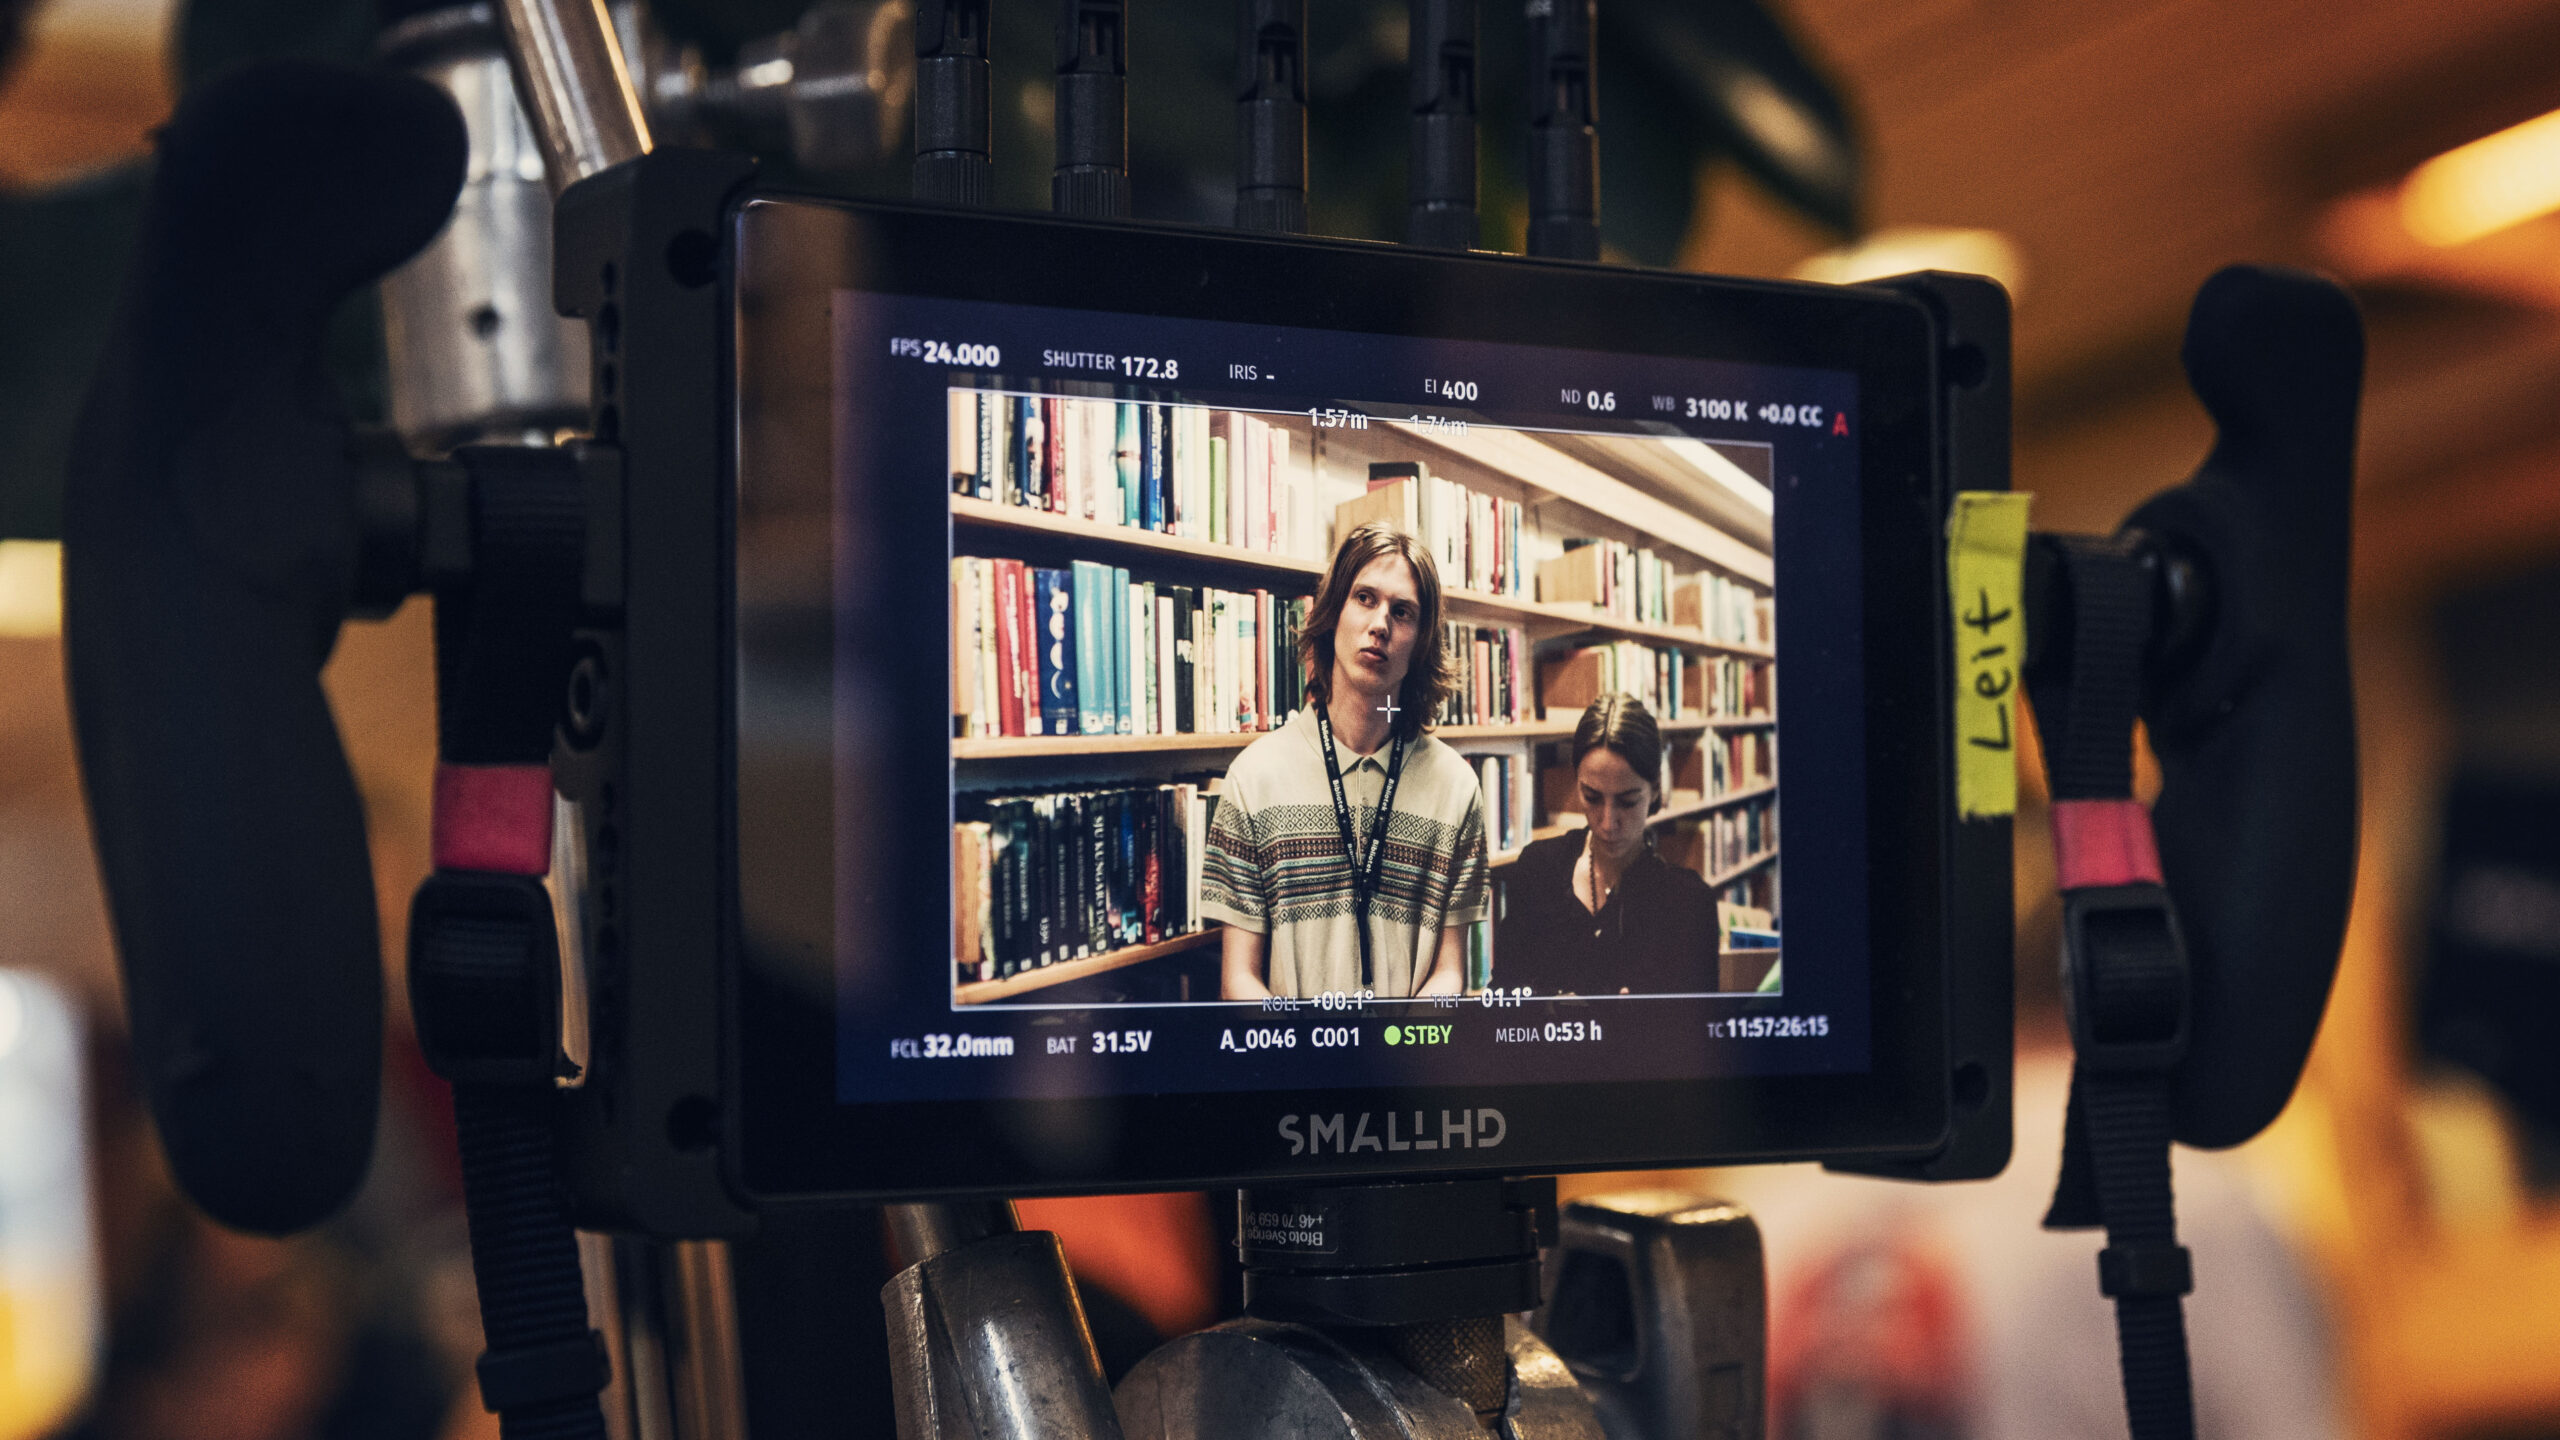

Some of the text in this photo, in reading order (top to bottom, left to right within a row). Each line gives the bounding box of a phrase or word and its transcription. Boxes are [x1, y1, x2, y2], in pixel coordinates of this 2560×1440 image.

[891, 338, 1000, 367] FPS 24.000
[1043, 349, 1179, 379] SHUTTER 172.8
[1229, 363, 1258, 381] IRIS
[1425, 378, 1478, 401] EI 400
[1561, 389, 1616, 411] ND 0.6
[1308, 407, 1368, 430] 1.57m
[1652, 396, 1823, 427] WB 3100 K +0.0 CC
[1409, 414, 1468, 436] 1.74m
[1832, 411, 1849, 436] A
[1964, 587, 2012, 751] Leif
[1332, 779, 1345, 814] Bibliotek
[1381, 778, 1395, 812] Bibliotek
[1365, 839, 1379, 874] Bibliotek
[1263, 996, 1300, 1012] ROLL
[1430, 993, 1460, 1008] TILT
[1403, 1025, 1452, 1045] STBY
[1496, 1020, 1602, 1043] MEDIA 0:53 h
[1708, 1016, 1829, 1038] TC 11:57:26:15
[892, 1034, 1014, 1059] FCL 32.0mm
[1046, 1030, 1152, 1054] BAT 31.5V
[1220, 1027, 1360, 1053] A_0046 C001
[1278, 1108, 1507, 1156] SMALLHD
[1258, 1212, 1279, 1227] 659
[1281, 1214, 1295, 1228] 70
[1298, 1214, 1323, 1228] +46
[1247, 1226, 1287, 1245] Sverige
[1289, 1231, 1323, 1246] Bfoto
